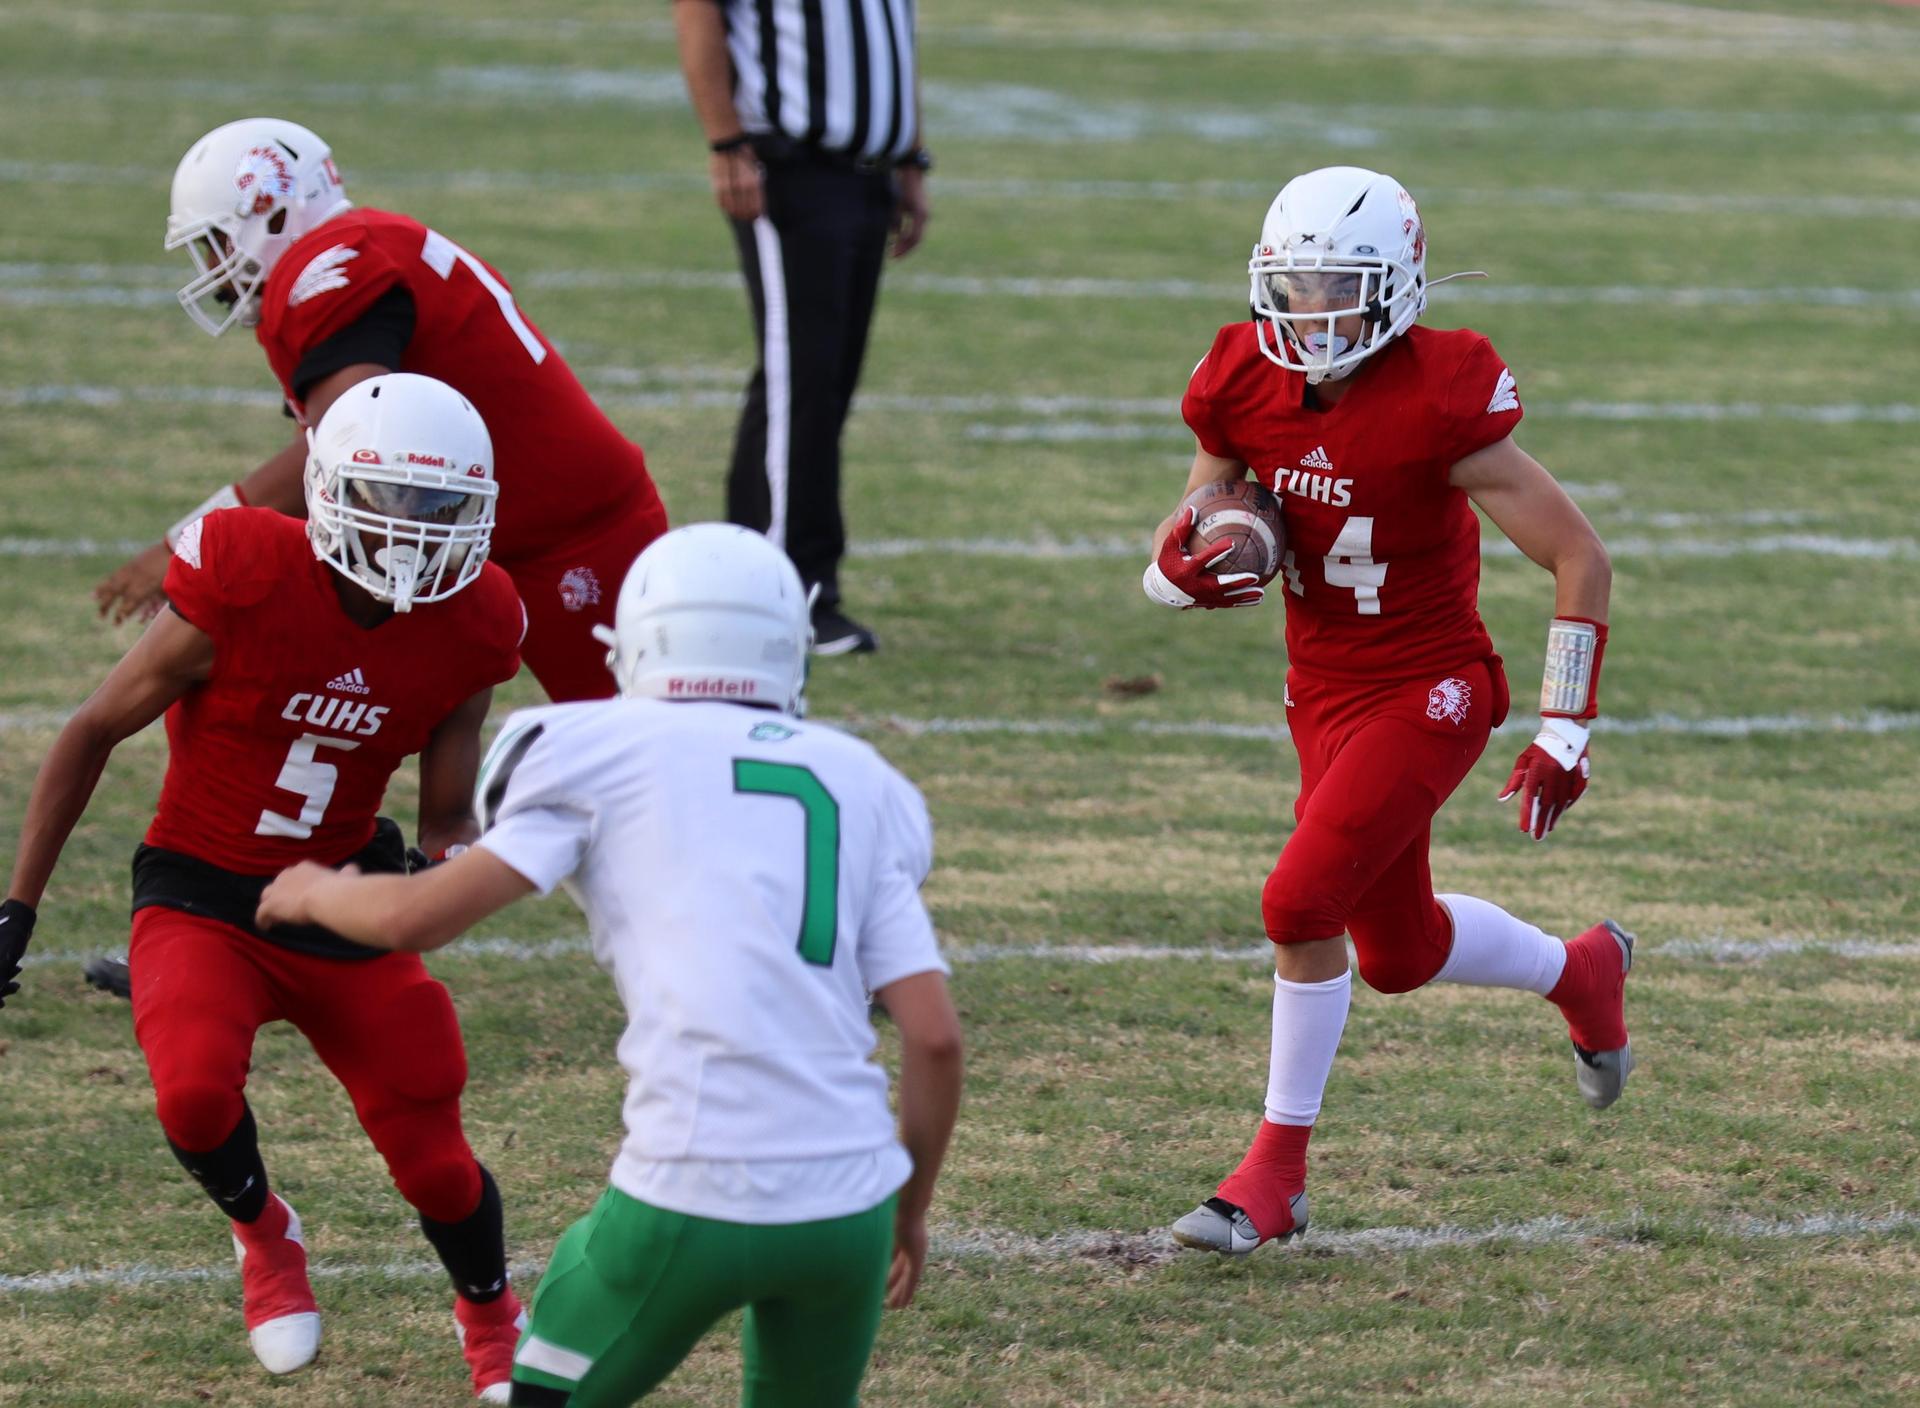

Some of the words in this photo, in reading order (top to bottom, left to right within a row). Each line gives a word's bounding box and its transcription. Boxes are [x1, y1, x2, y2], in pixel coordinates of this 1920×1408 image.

[408, 453, 445, 467] Riddell
[1300, 457, 1334, 471] adidas
[1273, 467, 1353, 507] CUHS
[326, 680, 370, 695] adidas
[668, 678, 756, 695] Riddell
[281, 692, 391, 736] CUHS
[254, 732, 361, 840] 5
[731, 757, 840, 969] 7
